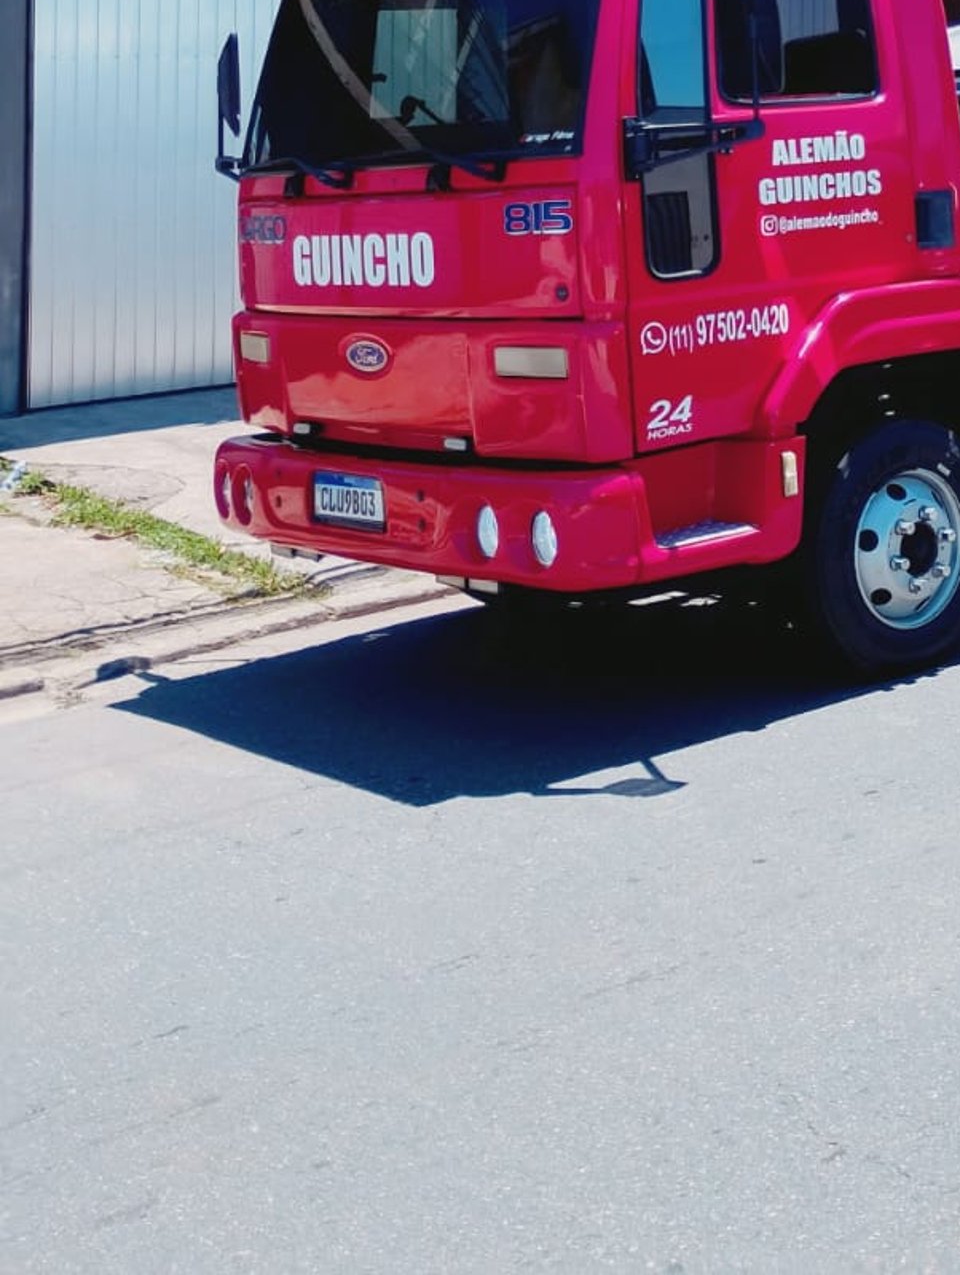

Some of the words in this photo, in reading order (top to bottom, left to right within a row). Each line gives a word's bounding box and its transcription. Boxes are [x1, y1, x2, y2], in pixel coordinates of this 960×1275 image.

[771, 130, 866, 166] ALEMÃO
[758, 169, 882, 206] GUINCHOS
[504, 199, 574, 236] 815
[293, 231, 435, 288] GUINCHO
[669, 324, 694, 356] (11)
[696, 303, 790, 346] 97502-0420
[647, 394, 693, 430] 24
[647, 423, 692, 441] HORAS
[321, 487, 376, 517] CLU9B03
